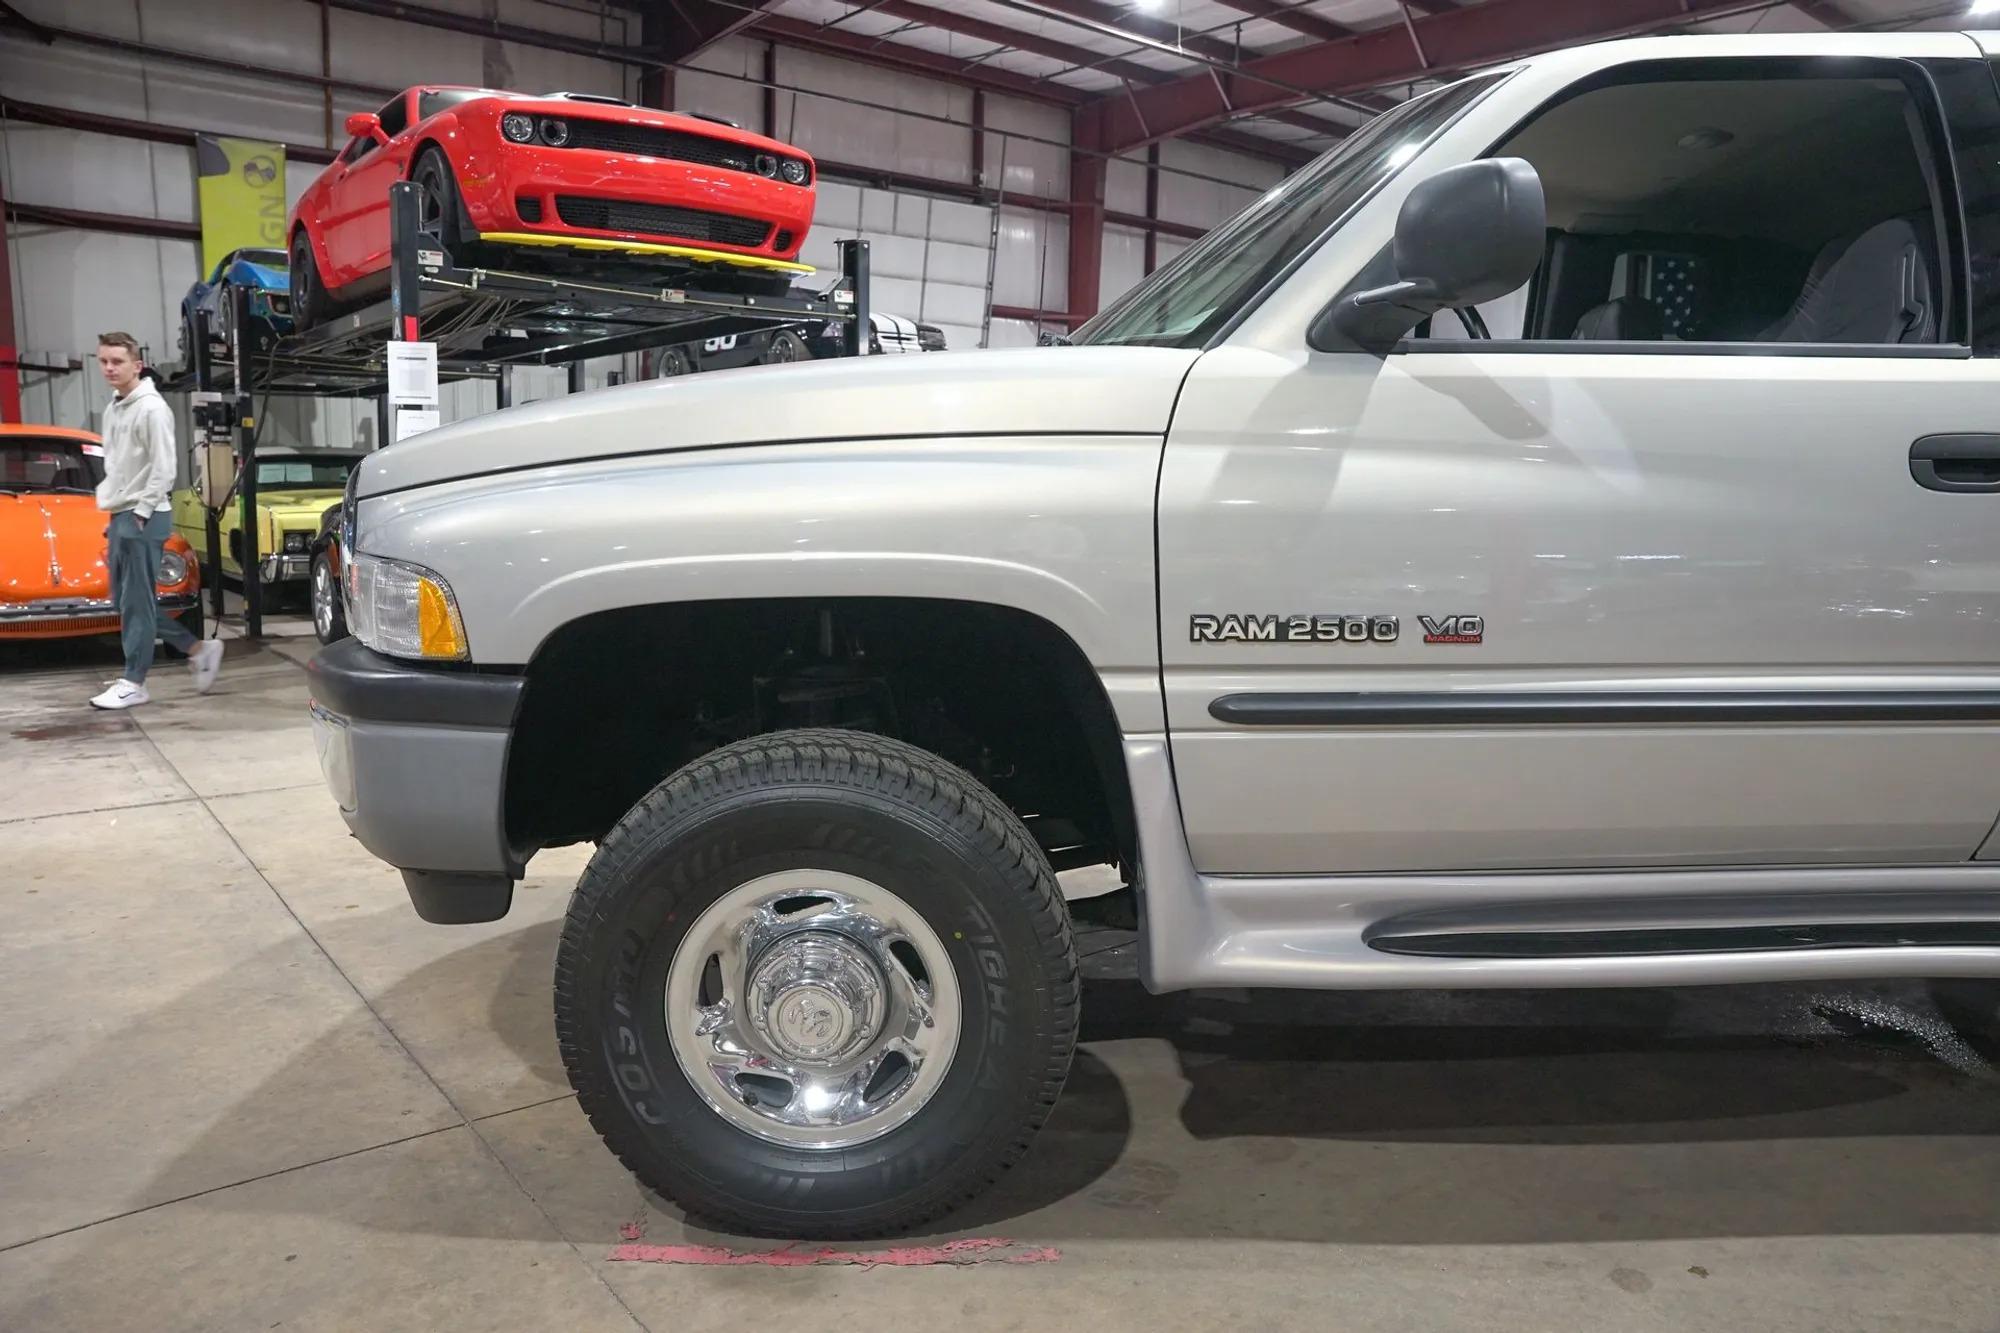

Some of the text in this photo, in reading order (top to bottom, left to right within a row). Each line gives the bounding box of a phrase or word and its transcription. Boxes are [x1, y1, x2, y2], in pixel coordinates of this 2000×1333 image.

[1190, 615, 1484, 642] RAM 2500 V10
[1424, 634, 1482, 644] MAGNUM
